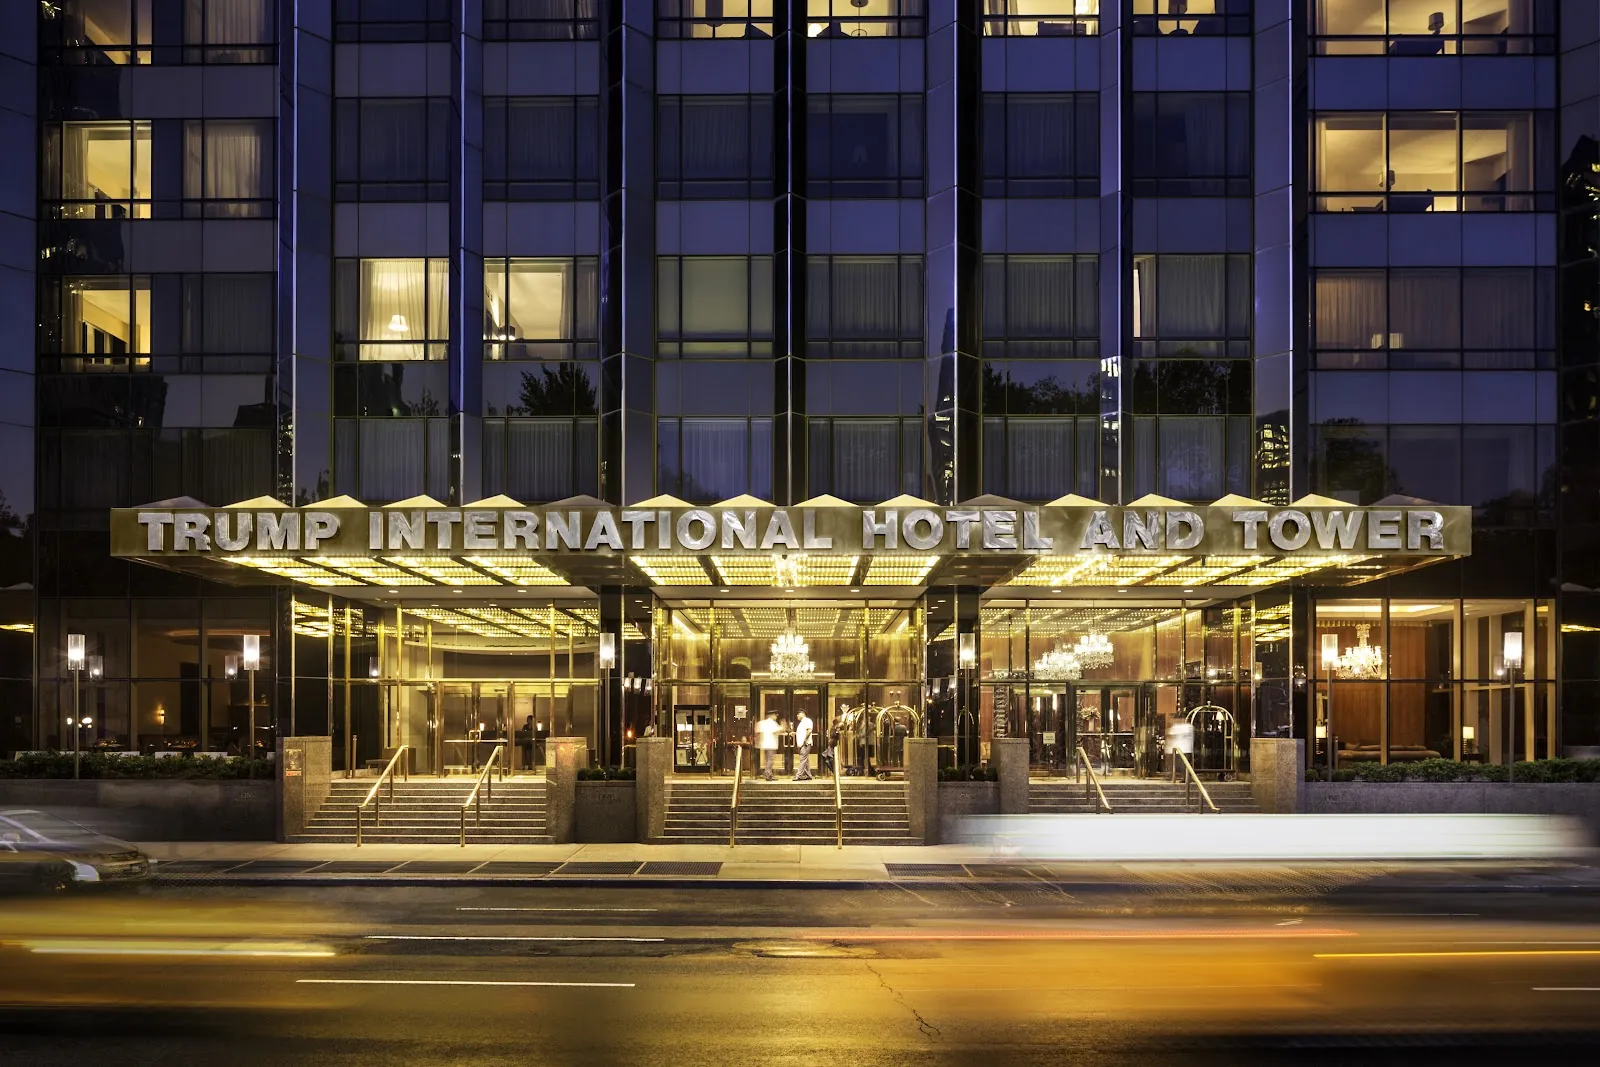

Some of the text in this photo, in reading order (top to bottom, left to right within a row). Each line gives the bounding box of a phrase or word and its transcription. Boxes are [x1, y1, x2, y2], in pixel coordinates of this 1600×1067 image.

[138, 509, 1444, 551] TRUMP INTERNATIONAL HOTEL AND TOWER
